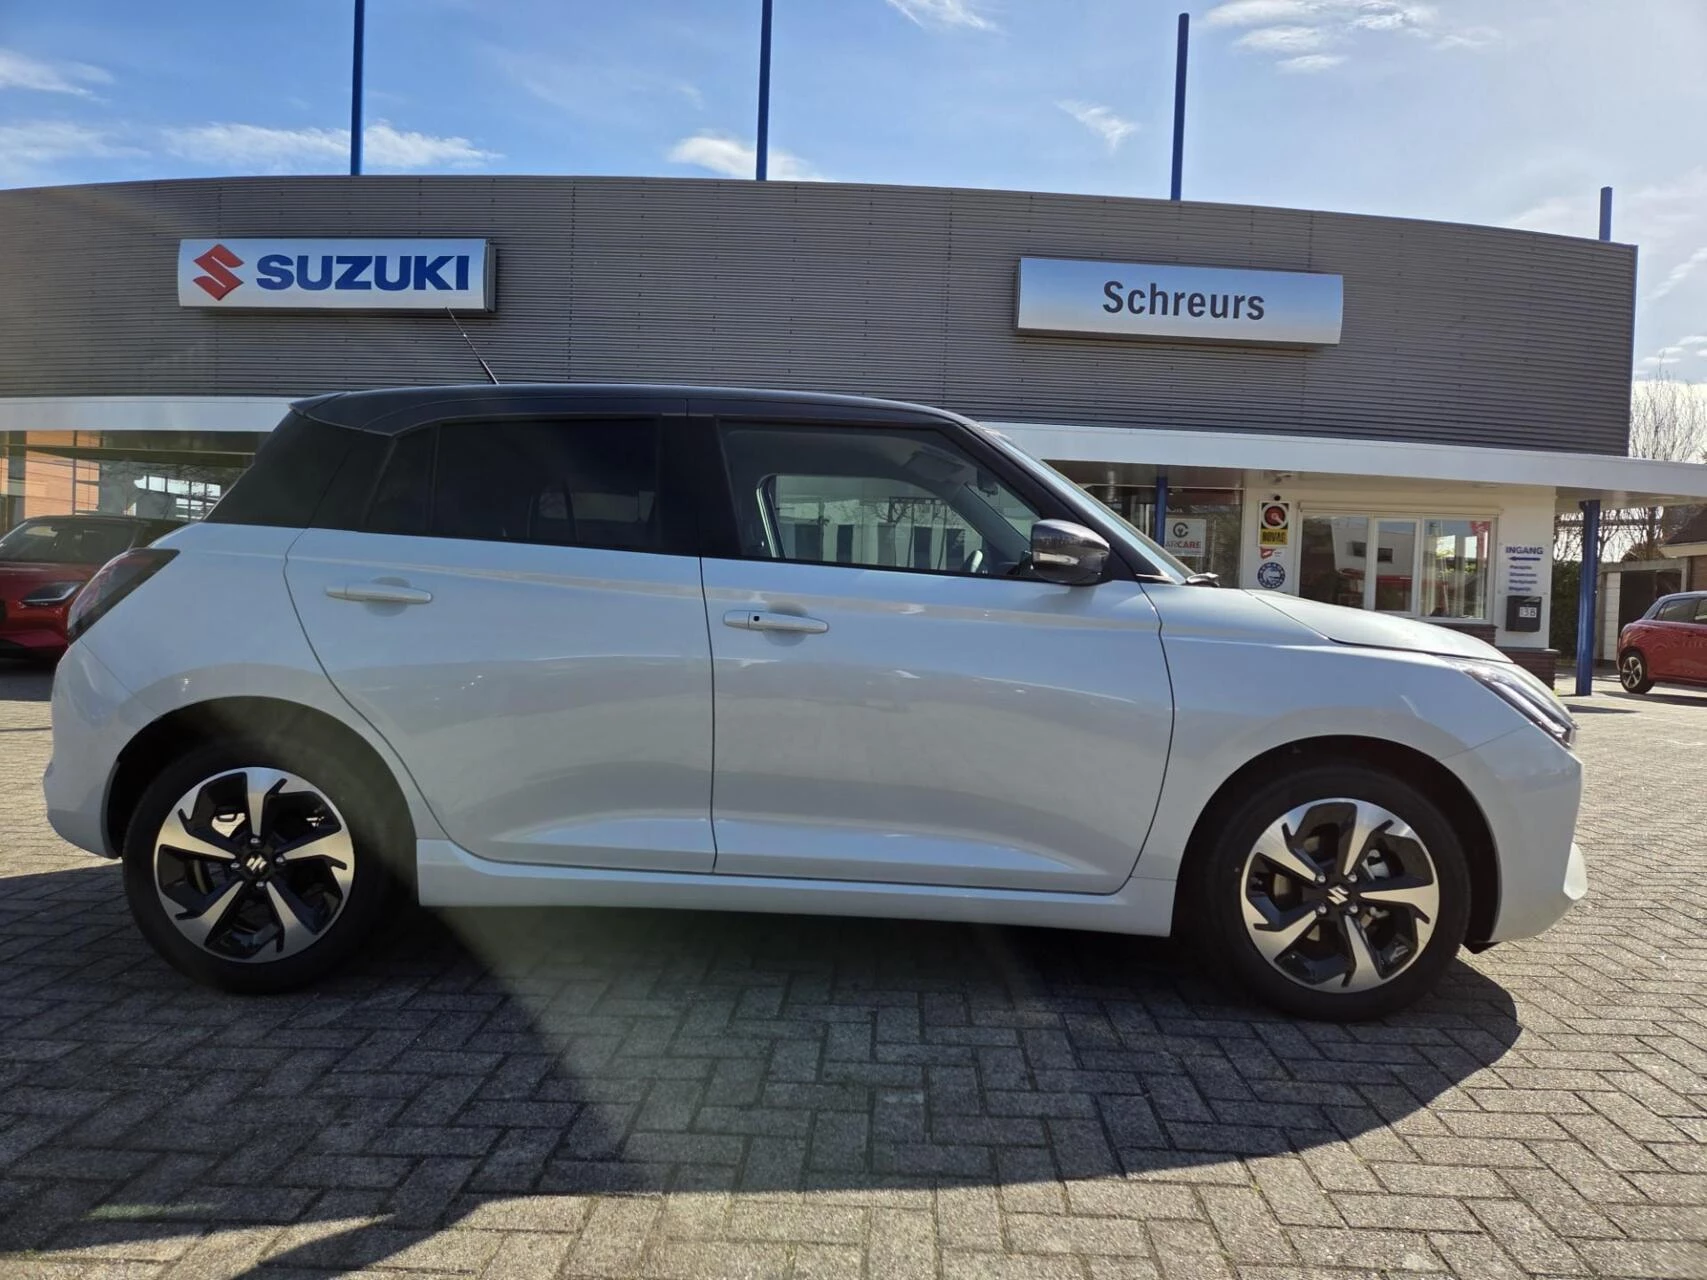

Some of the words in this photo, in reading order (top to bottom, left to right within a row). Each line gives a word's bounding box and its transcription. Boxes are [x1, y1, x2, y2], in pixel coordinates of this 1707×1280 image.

[256, 254, 470, 291] SUZUKI
[1102, 280, 1265, 320] Schreurs
[1505, 546, 1543, 555] INGANG
